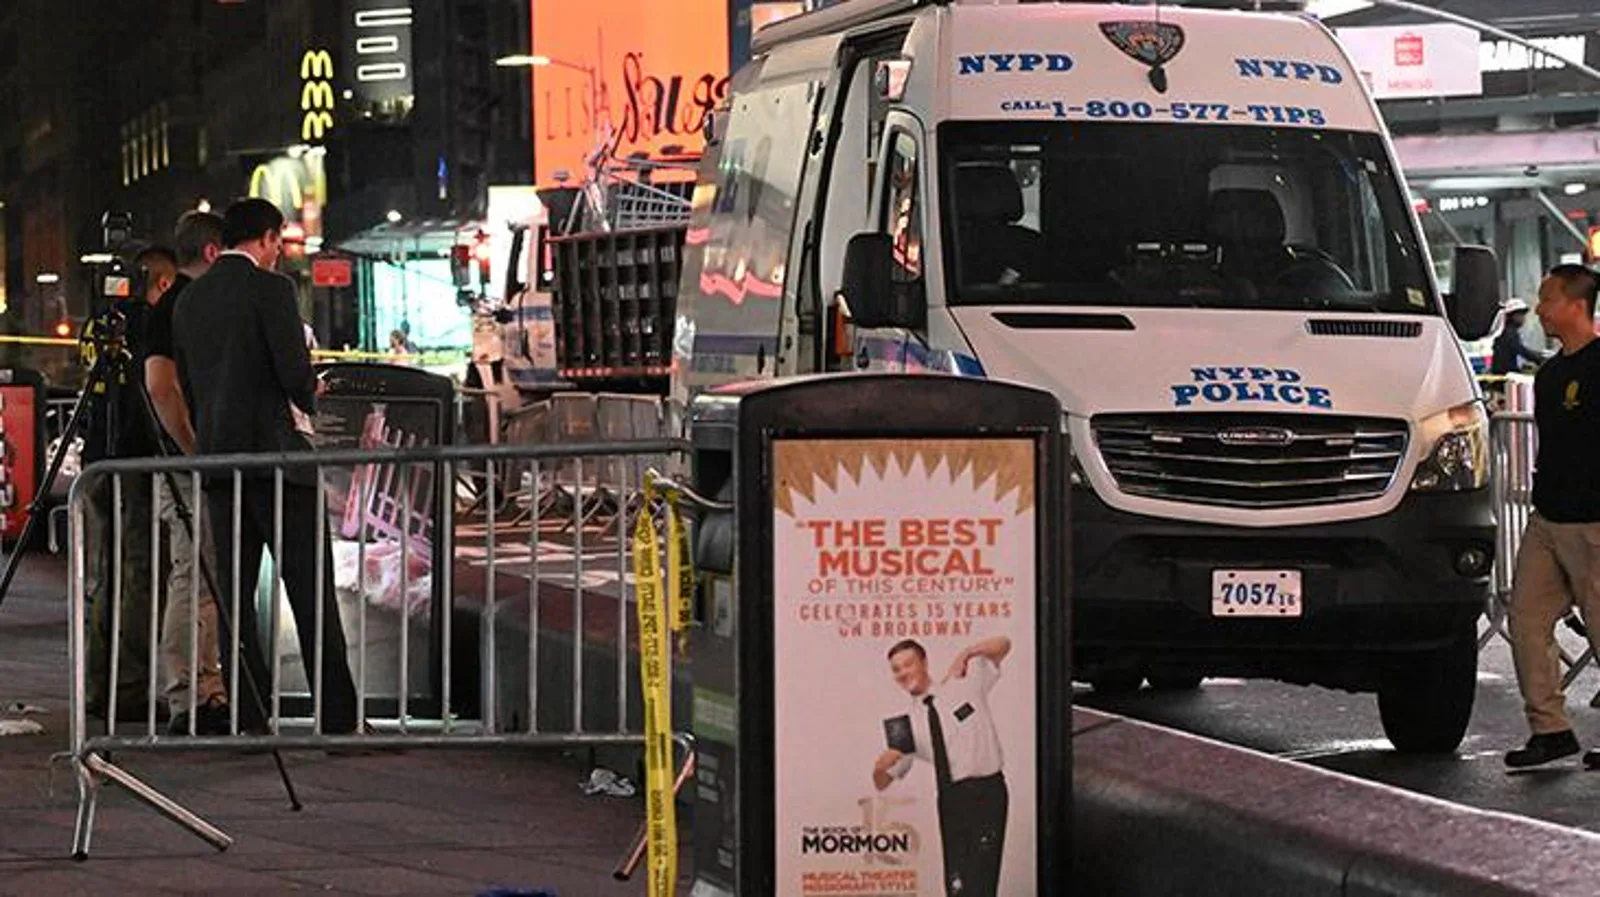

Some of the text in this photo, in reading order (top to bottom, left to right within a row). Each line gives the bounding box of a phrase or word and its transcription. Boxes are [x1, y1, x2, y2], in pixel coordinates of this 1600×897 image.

[958, 53, 1073, 75] NYPD
[1234, 58, 1342, 84] NYPD
[1051, 100, 1327, 126] 1-800-577-TIPS
[1190, 367, 1301, 383] NYPD
[1171, 383, 1332, 409] POLICE
[899, 519, 1004, 547] BEST
[818, 549, 994, 577] MUSICAL
[807, 578, 838, 594] OF
[847, 577, 894, 593] THIS
[1221, 583, 1277, 605] 7057
[953, 601, 1013, 619] YEARS
[872, 620, 974, 637] BROADWAY
[802, 833, 909, 853] MORMON
